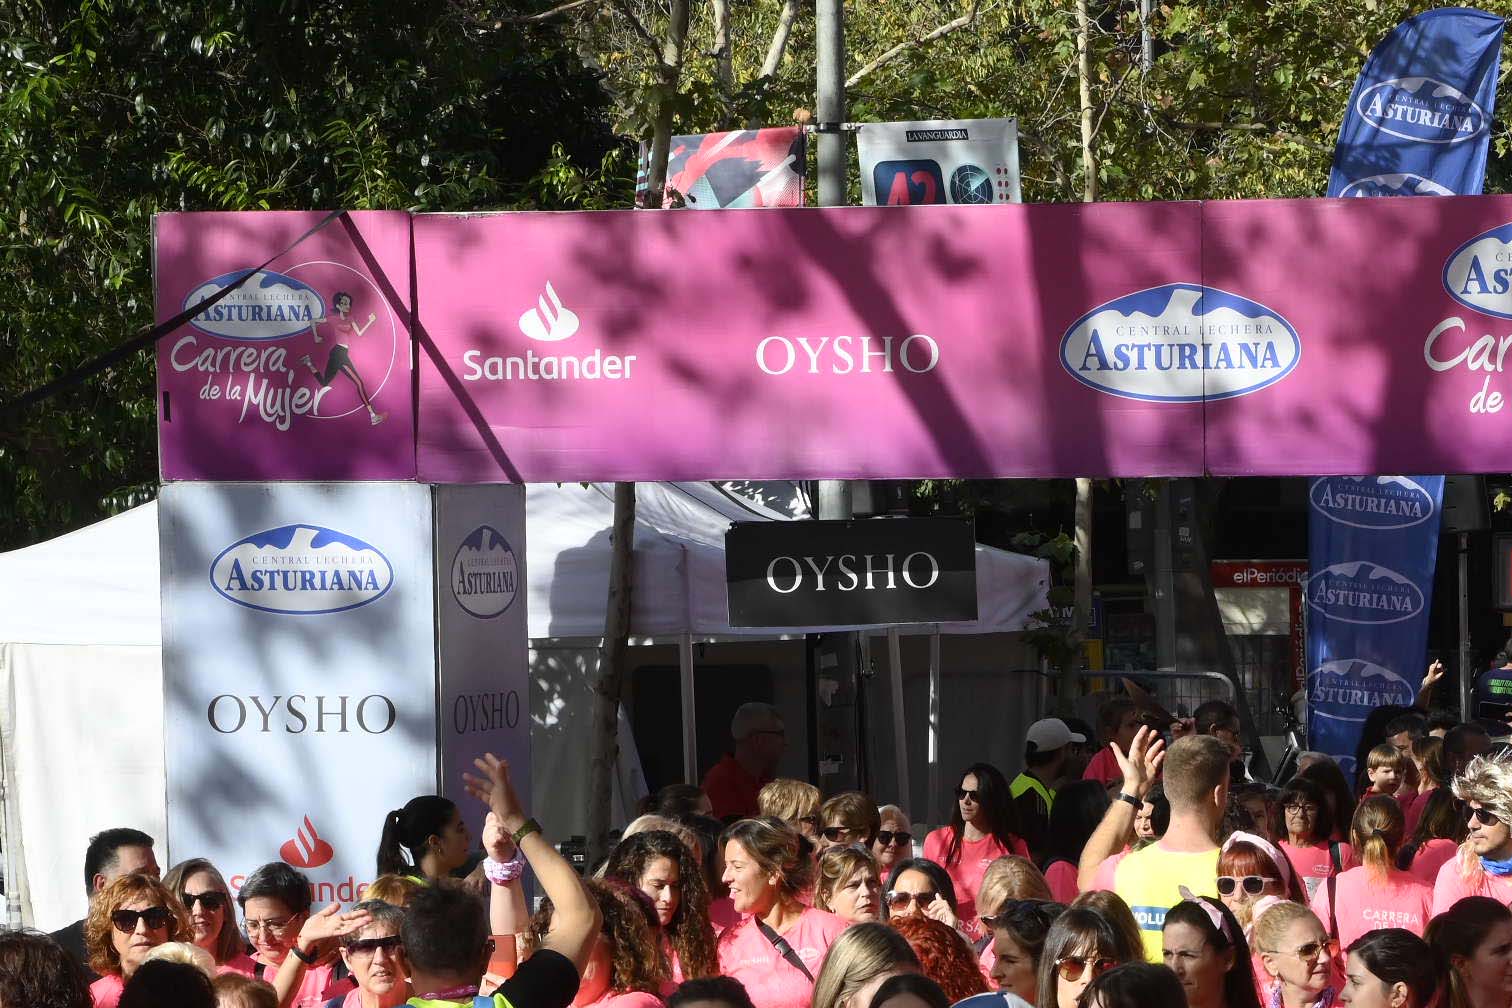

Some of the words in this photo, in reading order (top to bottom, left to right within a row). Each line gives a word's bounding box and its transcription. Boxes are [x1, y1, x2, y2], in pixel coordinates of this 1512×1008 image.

[1365, 92, 1474, 133] ASTURIANA
[1116, 325, 1191, 336] CENTRAL
[1199, 323, 1274, 336] LECHERA
[170, 335, 288, 373] Carrera
[462, 349, 637, 381] Santander
[755, 334, 940, 375] OYSHO
[1078, 328, 1283, 372] ASTURIANA
[199, 374, 222, 400] de
[225, 374, 242, 400] la
[238, 369, 333, 432] Mujer
[1469, 375, 1504, 414] de
[1321, 483, 1423, 518] ASTURIANA
[224, 557, 381, 592] ASTURIANA
[252, 556, 310, 565] CENTRAL
[316, 556, 374, 565] LECHERA
[456, 559, 515, 597] ASTURIANA
[766, 551, 940, 594] OYSHO
[1314, 579, 1414, 613] ASTURIANA
[207, 694, 397, 734] OYSHO
[453, 689, 520, 735] OYSHO
[1362, 908, 1420, 926] CARRERA
